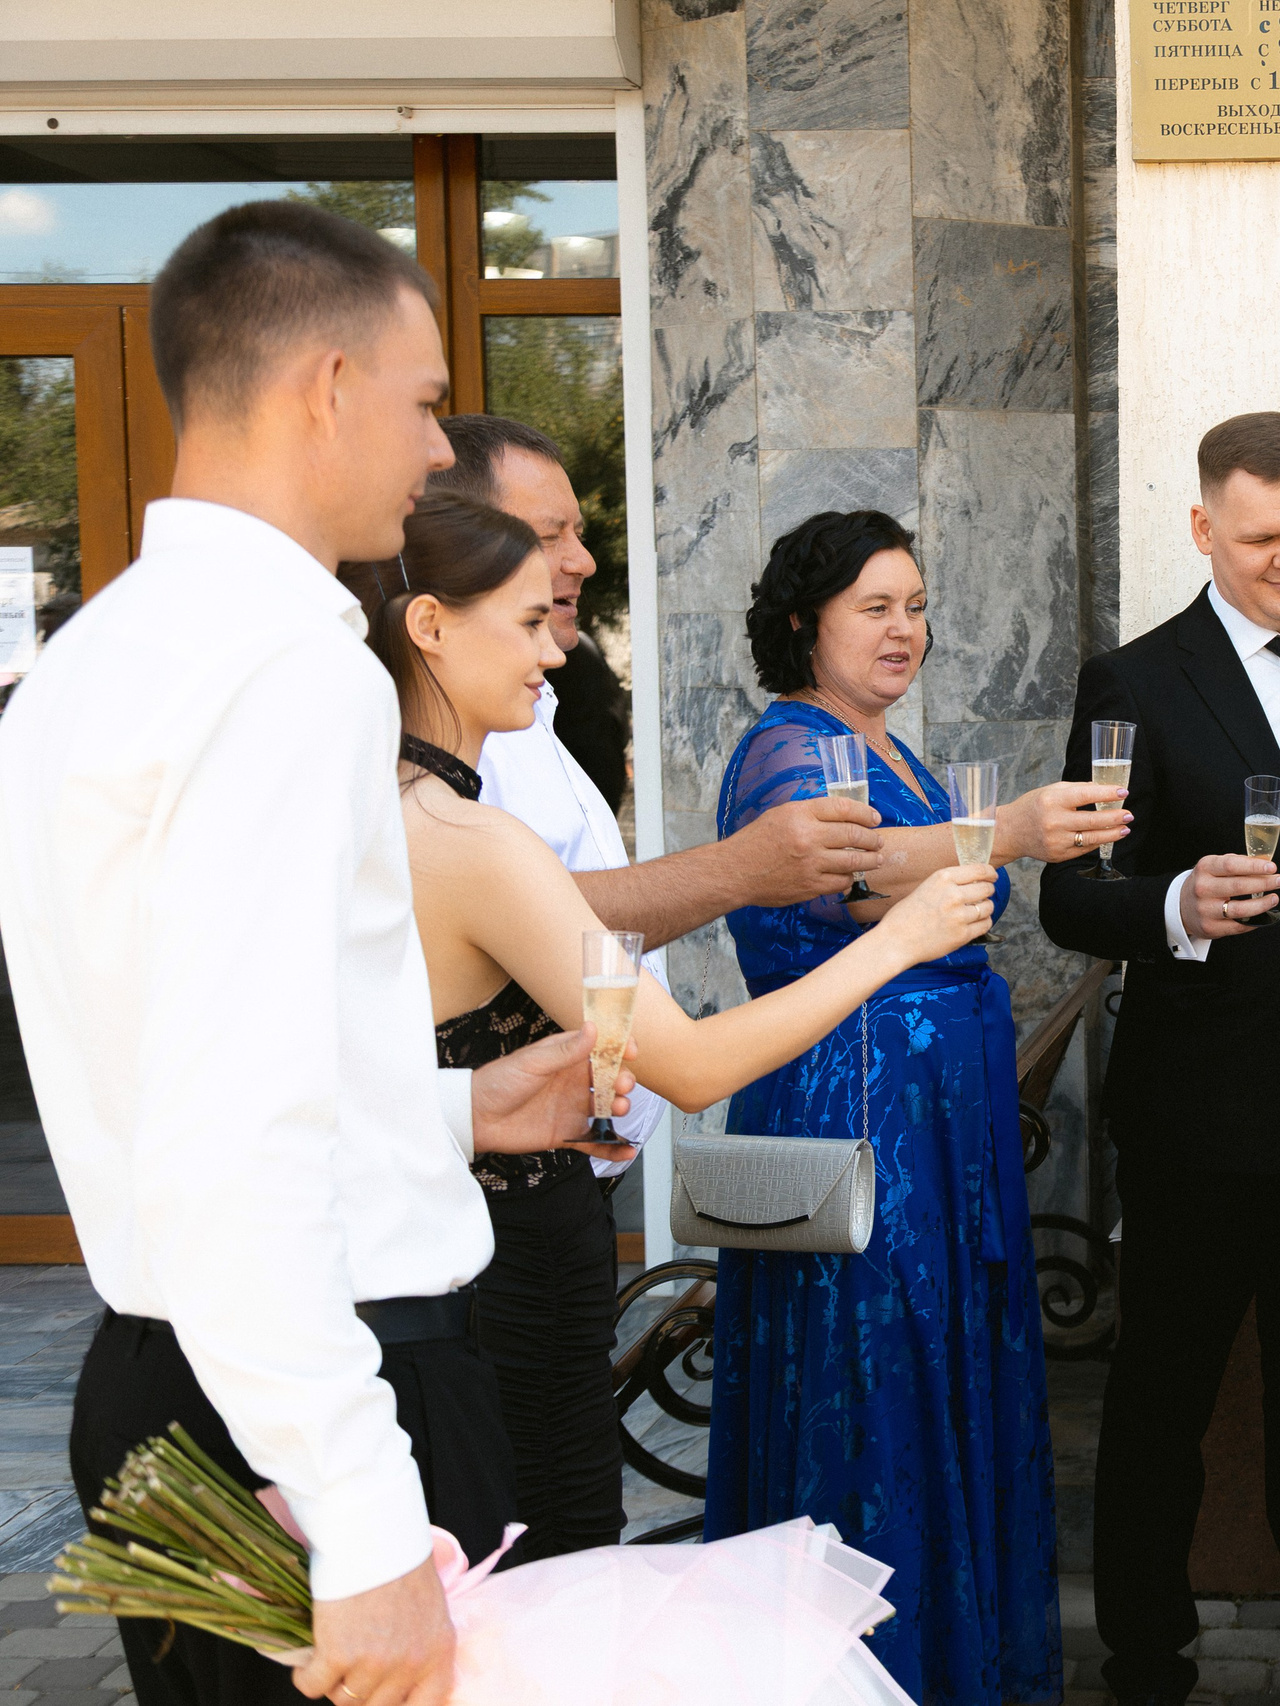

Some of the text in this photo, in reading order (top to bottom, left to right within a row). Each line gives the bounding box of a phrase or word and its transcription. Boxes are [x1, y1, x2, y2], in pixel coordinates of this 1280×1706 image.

[1153, 1, 1230, 14] ЧЕТВЕРГ
[1152, 18, 1233, 32] СУББОТА
[1154, 44, 1244, 59] ПЯТНИЦА
[1154, 78, 1239, 91] ПЕРЕРЫВ
